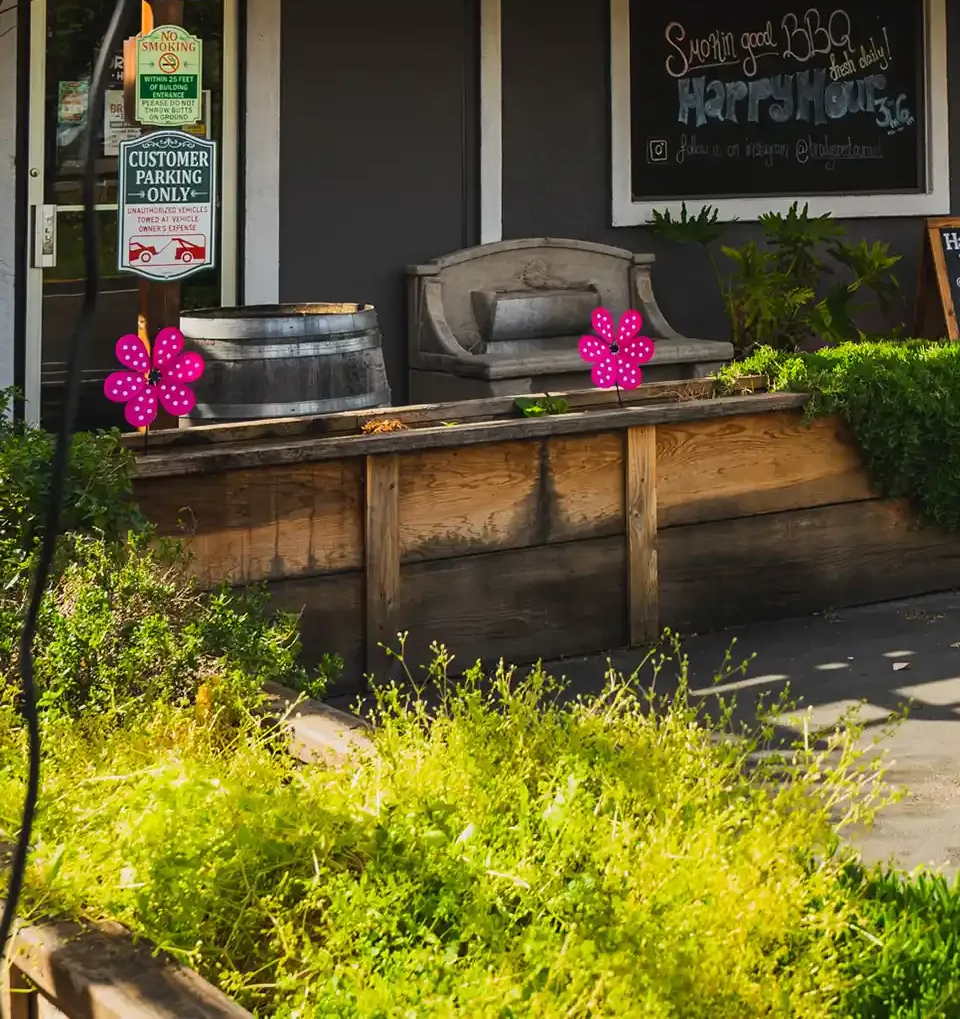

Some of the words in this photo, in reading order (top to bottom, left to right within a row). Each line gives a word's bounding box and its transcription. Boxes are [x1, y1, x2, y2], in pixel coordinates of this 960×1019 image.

[161, 31, 178, 41] NO
[142, 41, 196, 52] SMOKING
[741, 21, 779, 77] good
[781, 8, 856, 62] BBQ
[149, 83, 159, 91] OF
[159, 83, 189, 91] BUILDING
[152, 91, 185, 99] ENTRANCE
[141, 99, 168, 107] PLEASE
[148, 113, 159, 121] ON
[160, 113, 189, 121] GROUND
[128, 150, 209, 168] CUSTOMER
[135, 169, 203, 185] PARKING
[147, 186, 191, 202] ONLY
[127, 206, 177, 215] UNAUTHORIZED
[178, 205, 209, 214] VEHICLES
[171, 215, 200, 223] VEHICLE
[168, 224, 197, 232] EXPENSE
